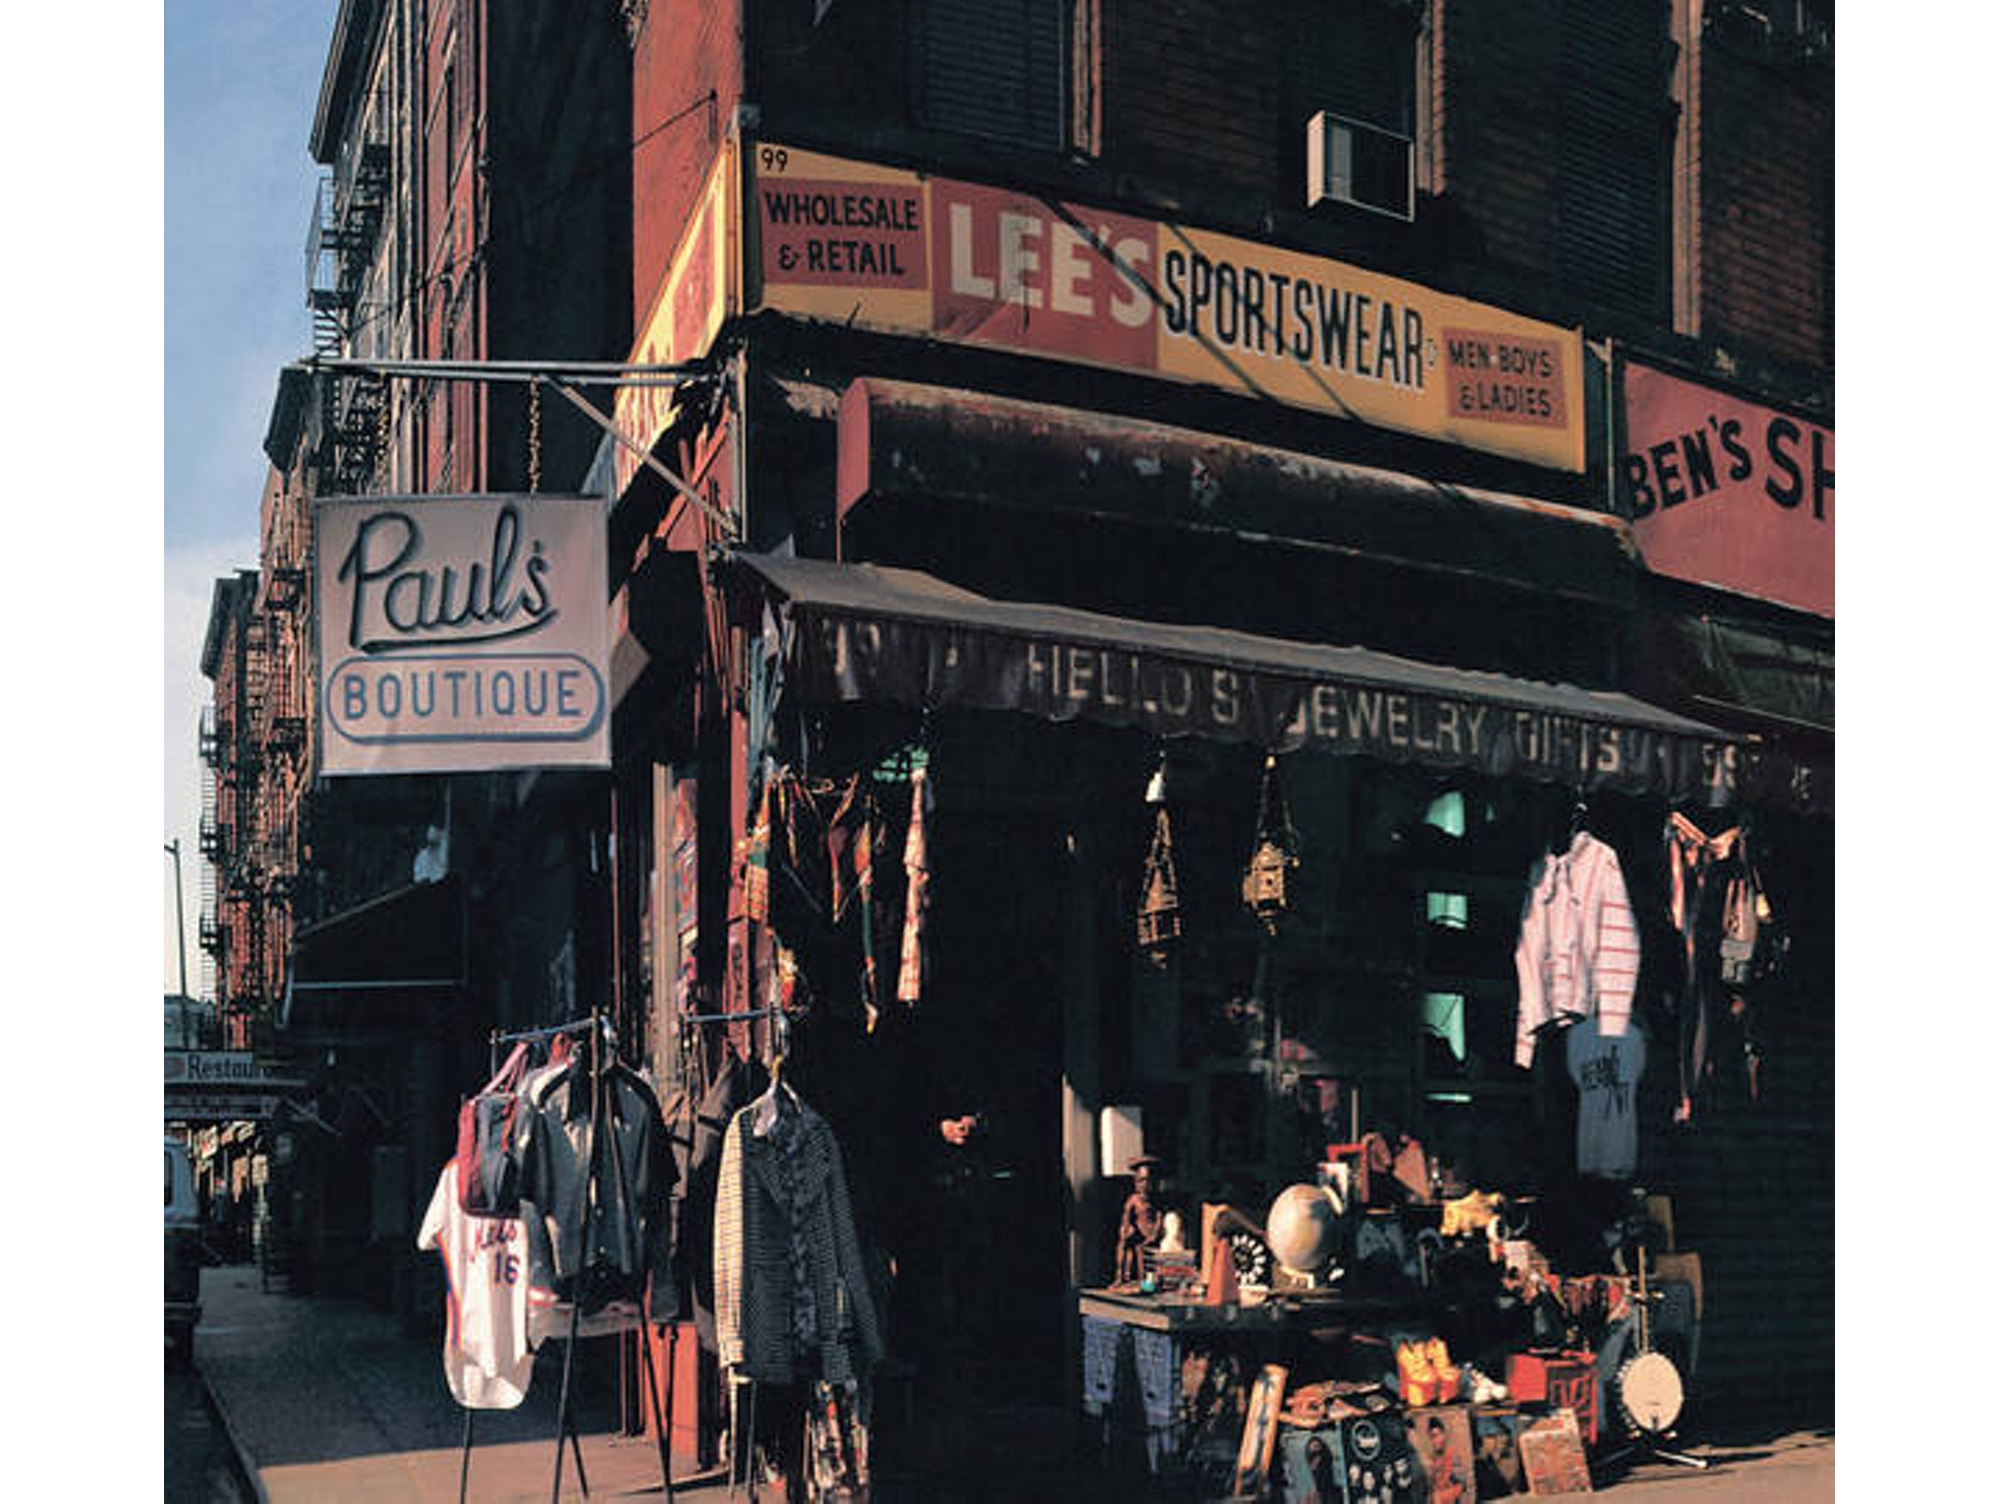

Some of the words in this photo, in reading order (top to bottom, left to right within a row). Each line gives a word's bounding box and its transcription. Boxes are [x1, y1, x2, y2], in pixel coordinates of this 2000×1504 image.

[761, 148, 788, 173] 99
[764, 190, 919, 231] WHOLESALE
[778, 243, 801, 271] &
[806, 238, 905, 276] RETAIL
[949, 203, 1153, 329] LEE'S
[1164, 250, 1426, 392] SPORTSWEAR
[1448, 339, 1490, 368] MEN
[1498, 344, 1552, 378] BOYS
[1627, 415, 1752, 520] BEN'S
[338, 505, 548, 649] Paul's
[343, 671, 582, 720] BOUTIQUE
[495, 1250, 520, 1286] 16
